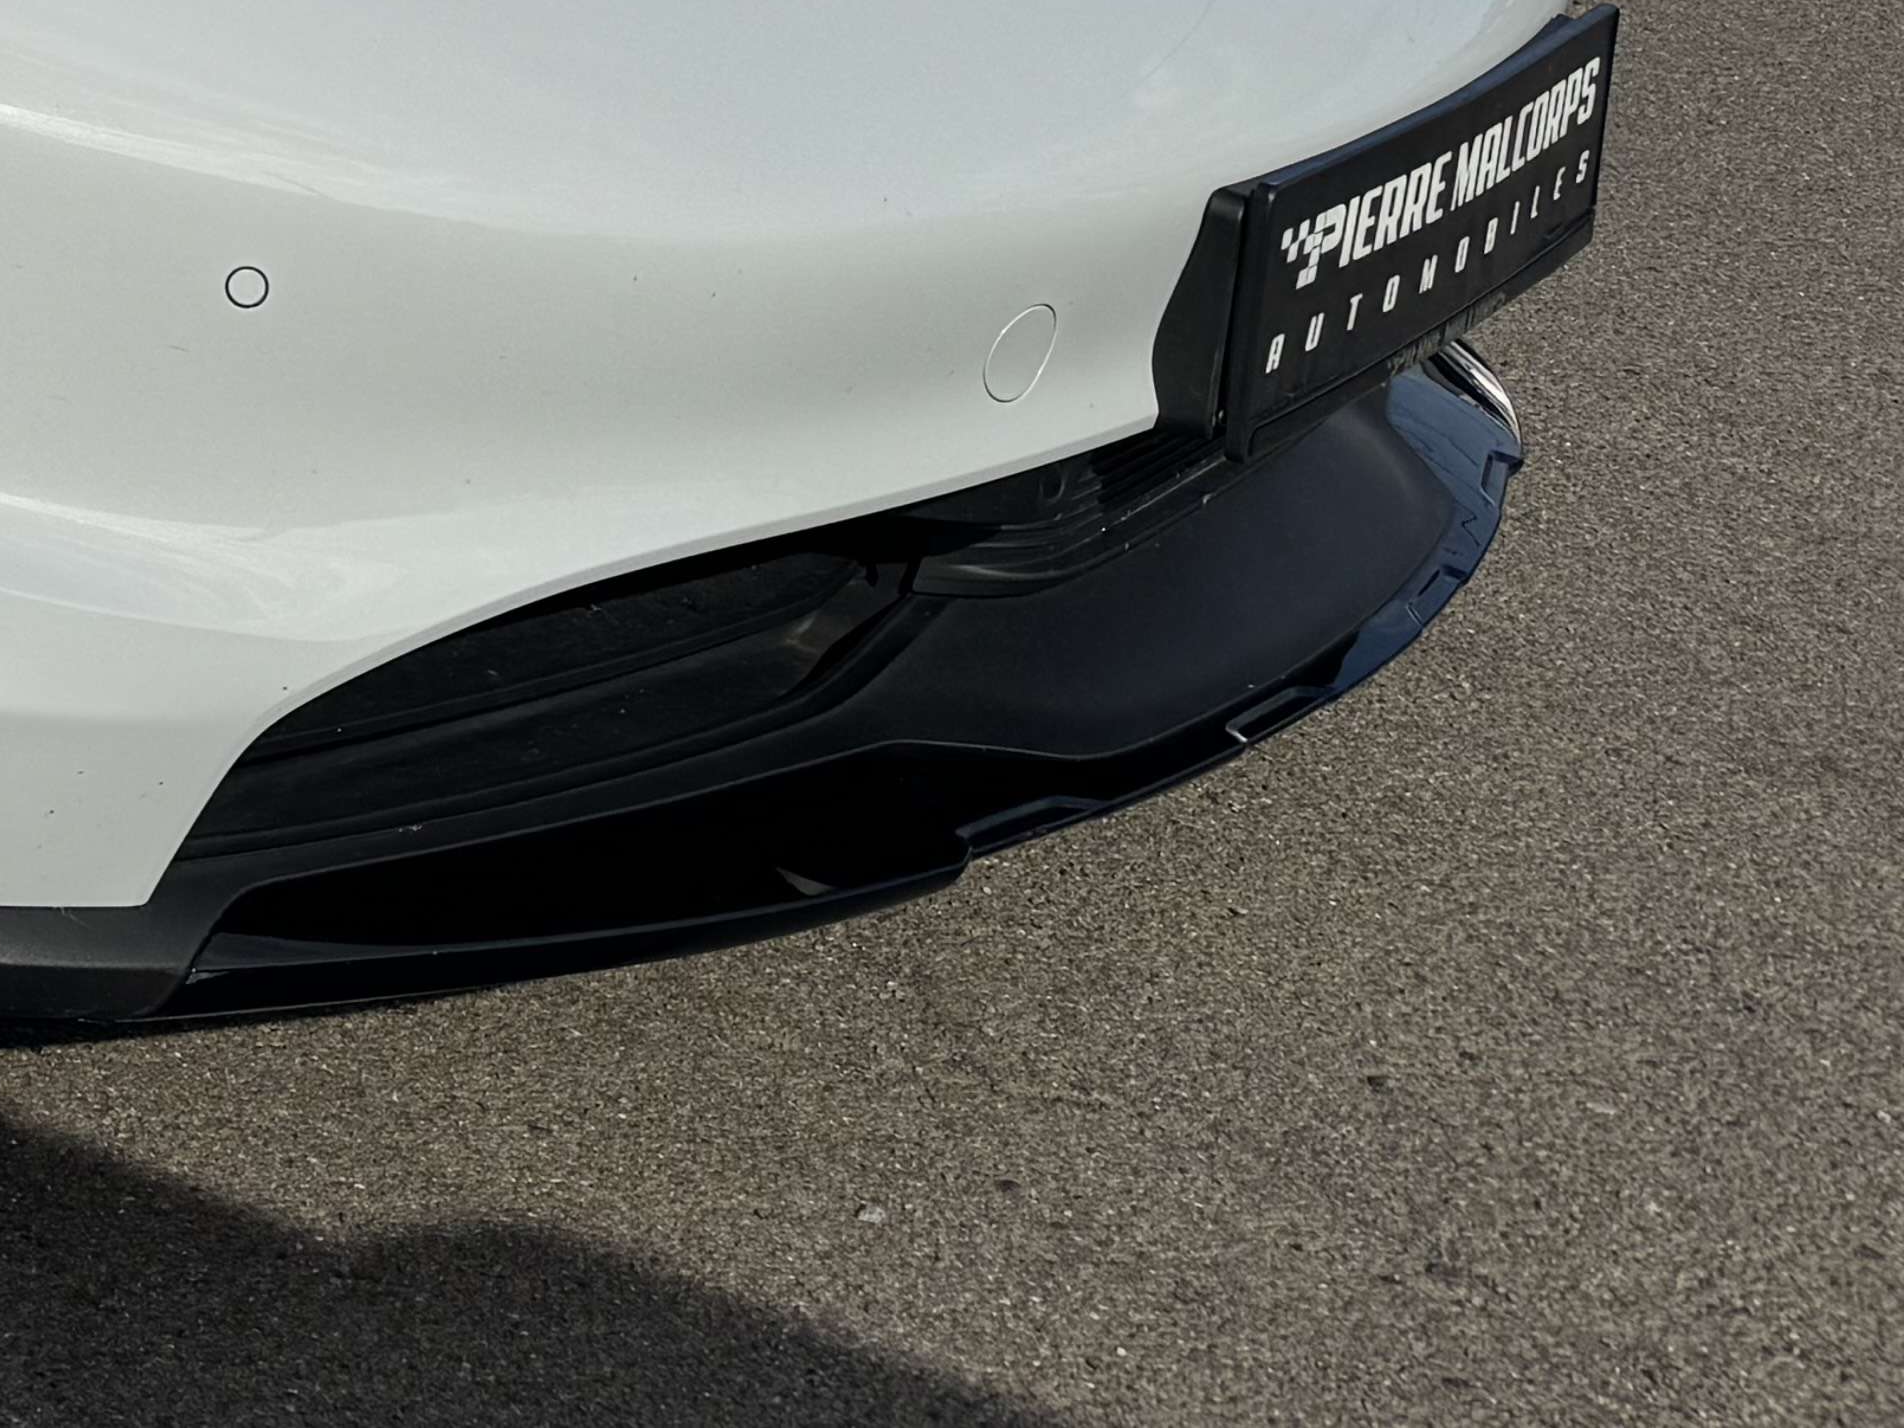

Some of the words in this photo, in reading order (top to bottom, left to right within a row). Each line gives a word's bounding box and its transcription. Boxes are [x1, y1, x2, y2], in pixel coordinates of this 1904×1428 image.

[1265, 150, 1590, 374] AUTOMOBILES
[1296, 151, 1452, 290] PIERRE
[1450, 57, 1600, 213] MALCORPS
